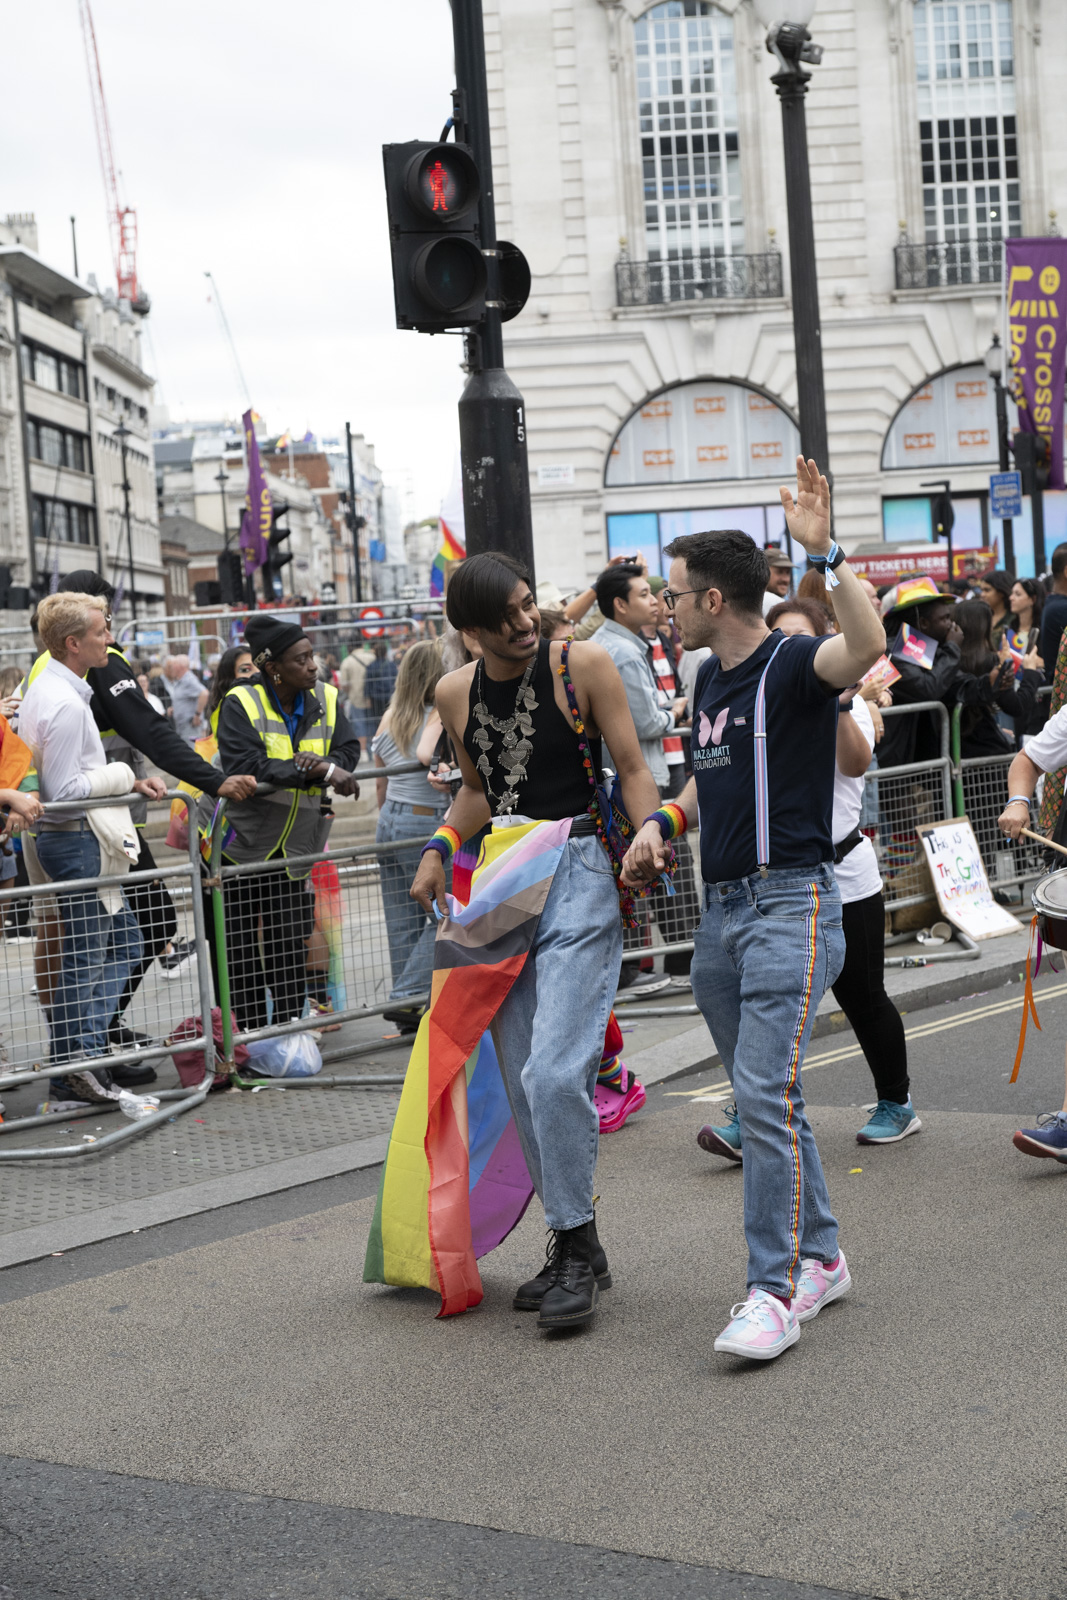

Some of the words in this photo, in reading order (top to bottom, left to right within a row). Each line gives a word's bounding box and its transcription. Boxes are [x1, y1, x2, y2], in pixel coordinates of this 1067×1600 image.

[868, 558, 915, 572] TICKETS
[917, 556, 948, 569] HERE
[693, 756, 732, 770] FOUNDATION
